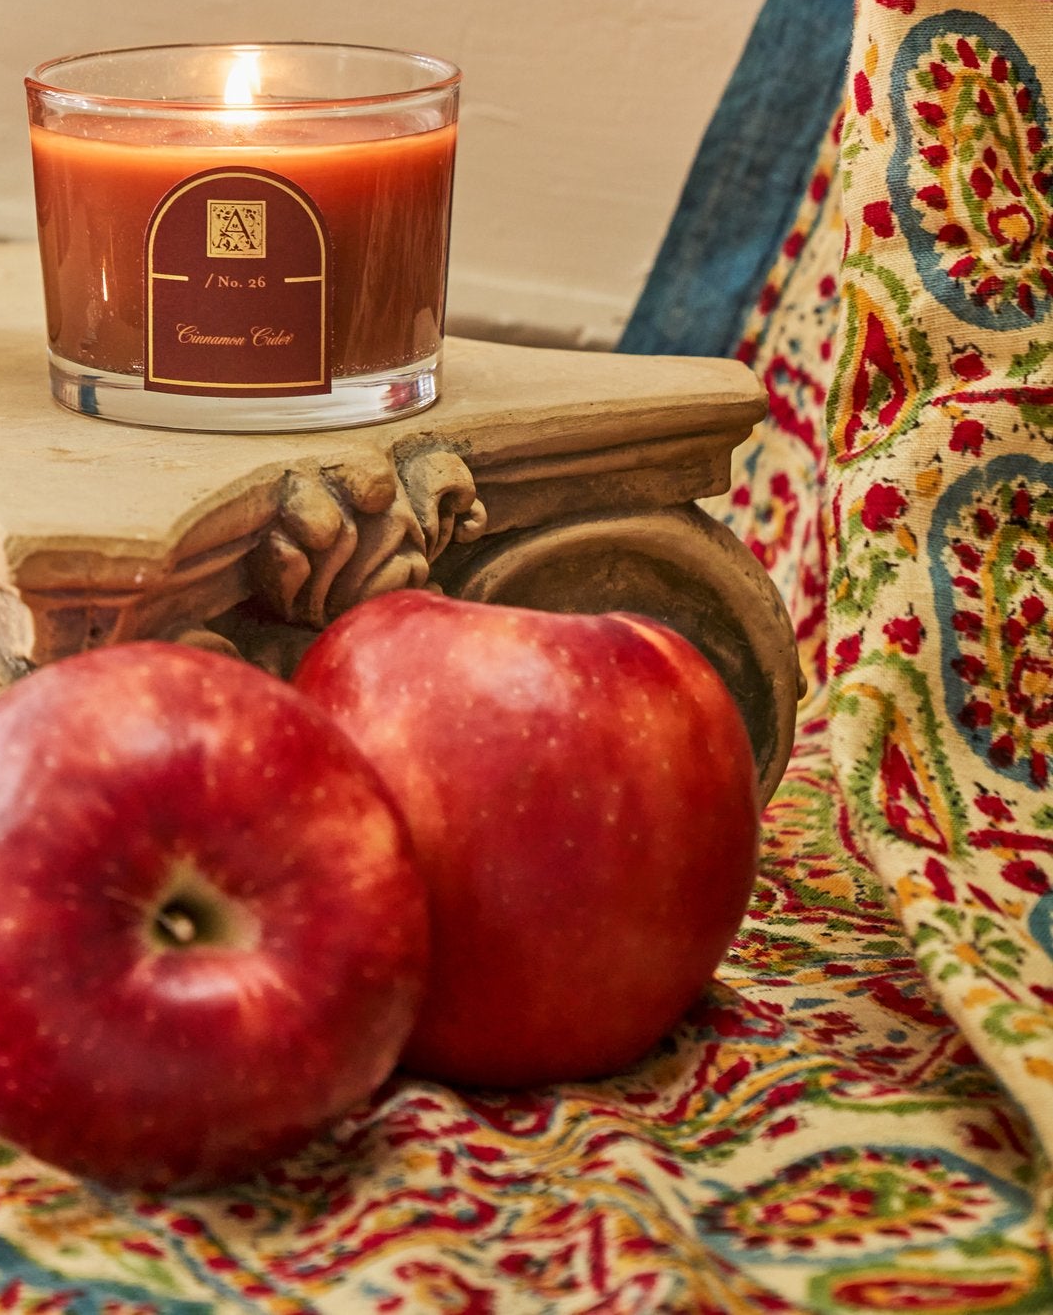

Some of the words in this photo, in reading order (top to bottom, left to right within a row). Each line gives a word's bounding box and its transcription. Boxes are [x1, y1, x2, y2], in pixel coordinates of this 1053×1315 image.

[218, 275, 243, 288] No.
[248, 276, 266, 288] 26
[176, 323, 247, 346] Cinnamon
